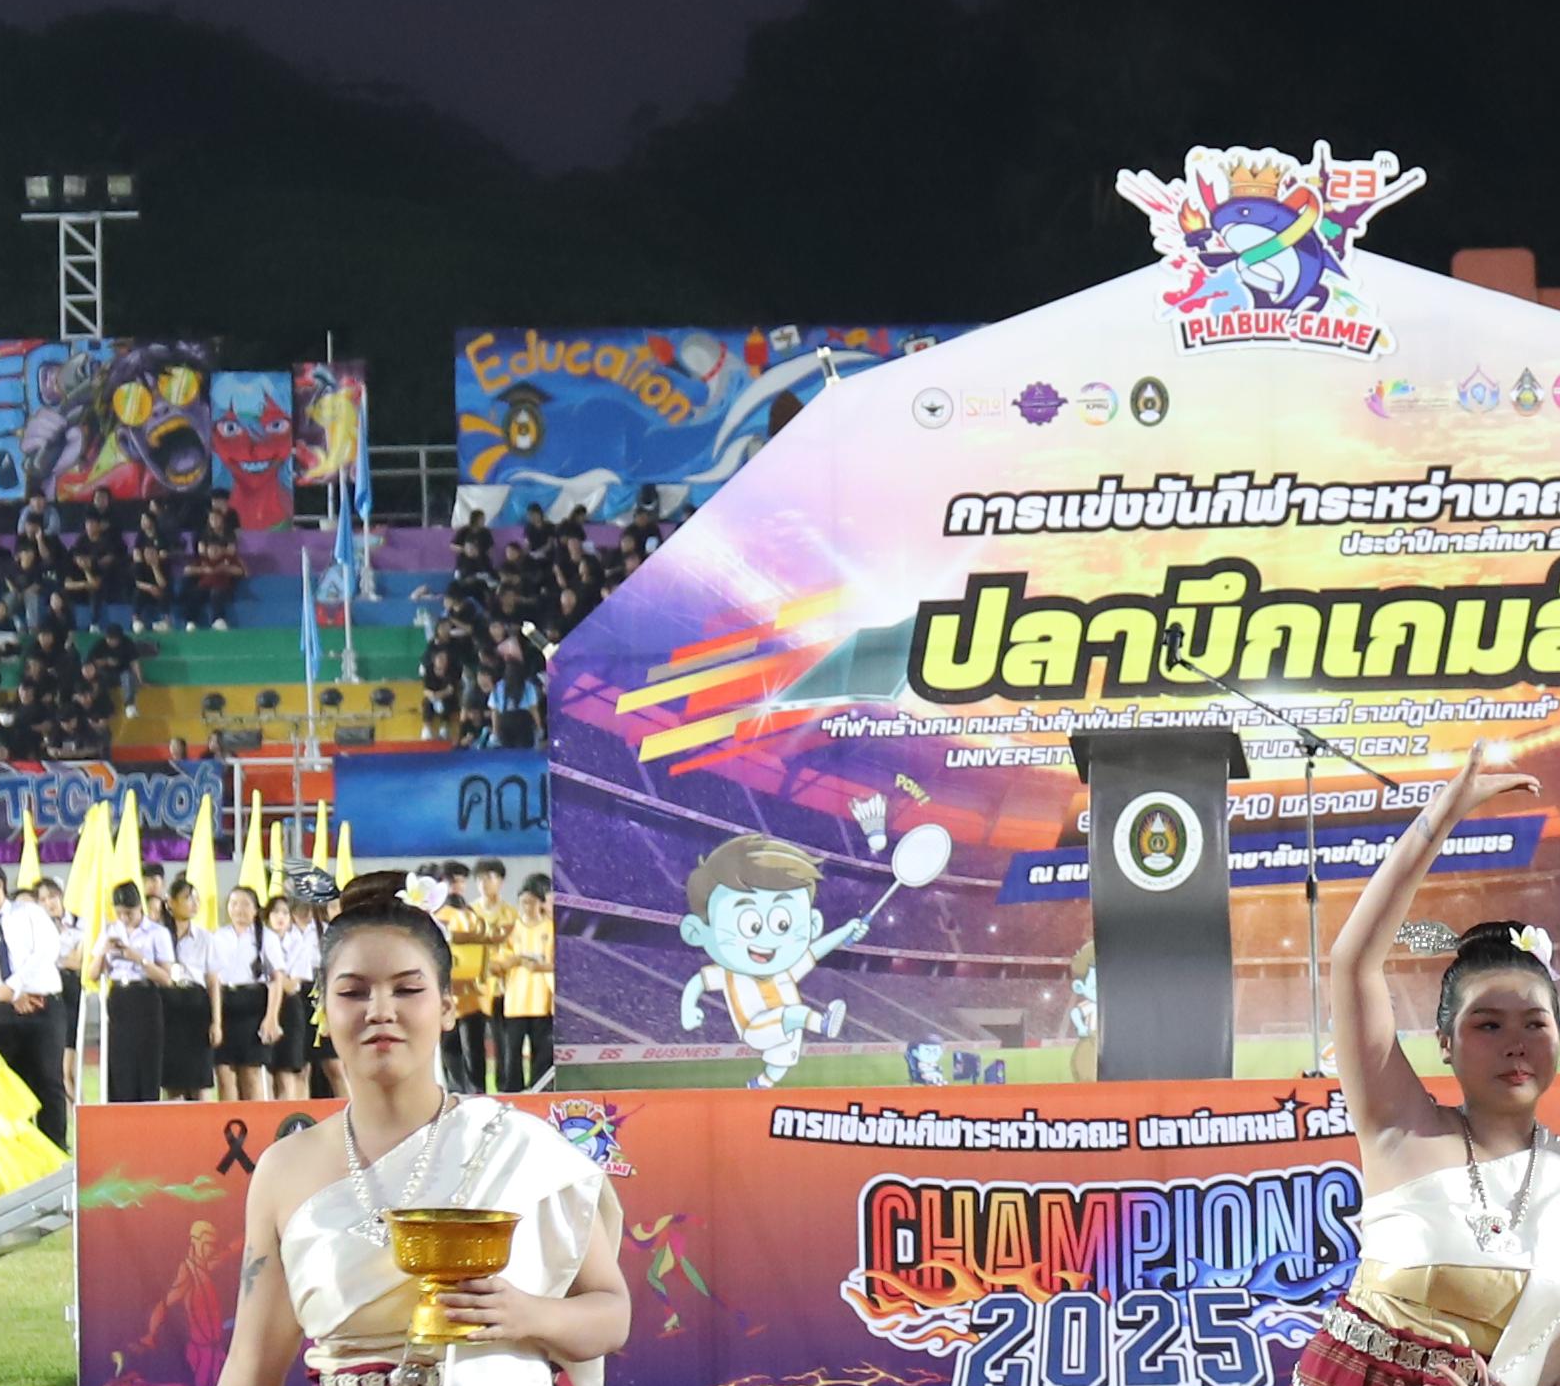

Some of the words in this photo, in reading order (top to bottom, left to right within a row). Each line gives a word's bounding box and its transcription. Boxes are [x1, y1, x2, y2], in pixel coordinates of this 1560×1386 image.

[1328, 169, 1377, 199] 23
[1187, 310, 1288, 343] PLABUK
[1299, 313, 1374, 348] GAME
[465, 329, 692, 425] Education
[1341, 529, 1546, 556] ประจำปีการศึกษา
[1359, 737, 1411, 757] GEN
[1412, 736, 1429, 754] Z
[895, 771, 932, 807] POW!
[642, 1046, 721, 1060] BUSINESS
[772, 1104, 1128, 1149] การแข่งขันกีฬาระหว่างคณะ
[870, 1173, 1359, 1299] CHAMPIONS
